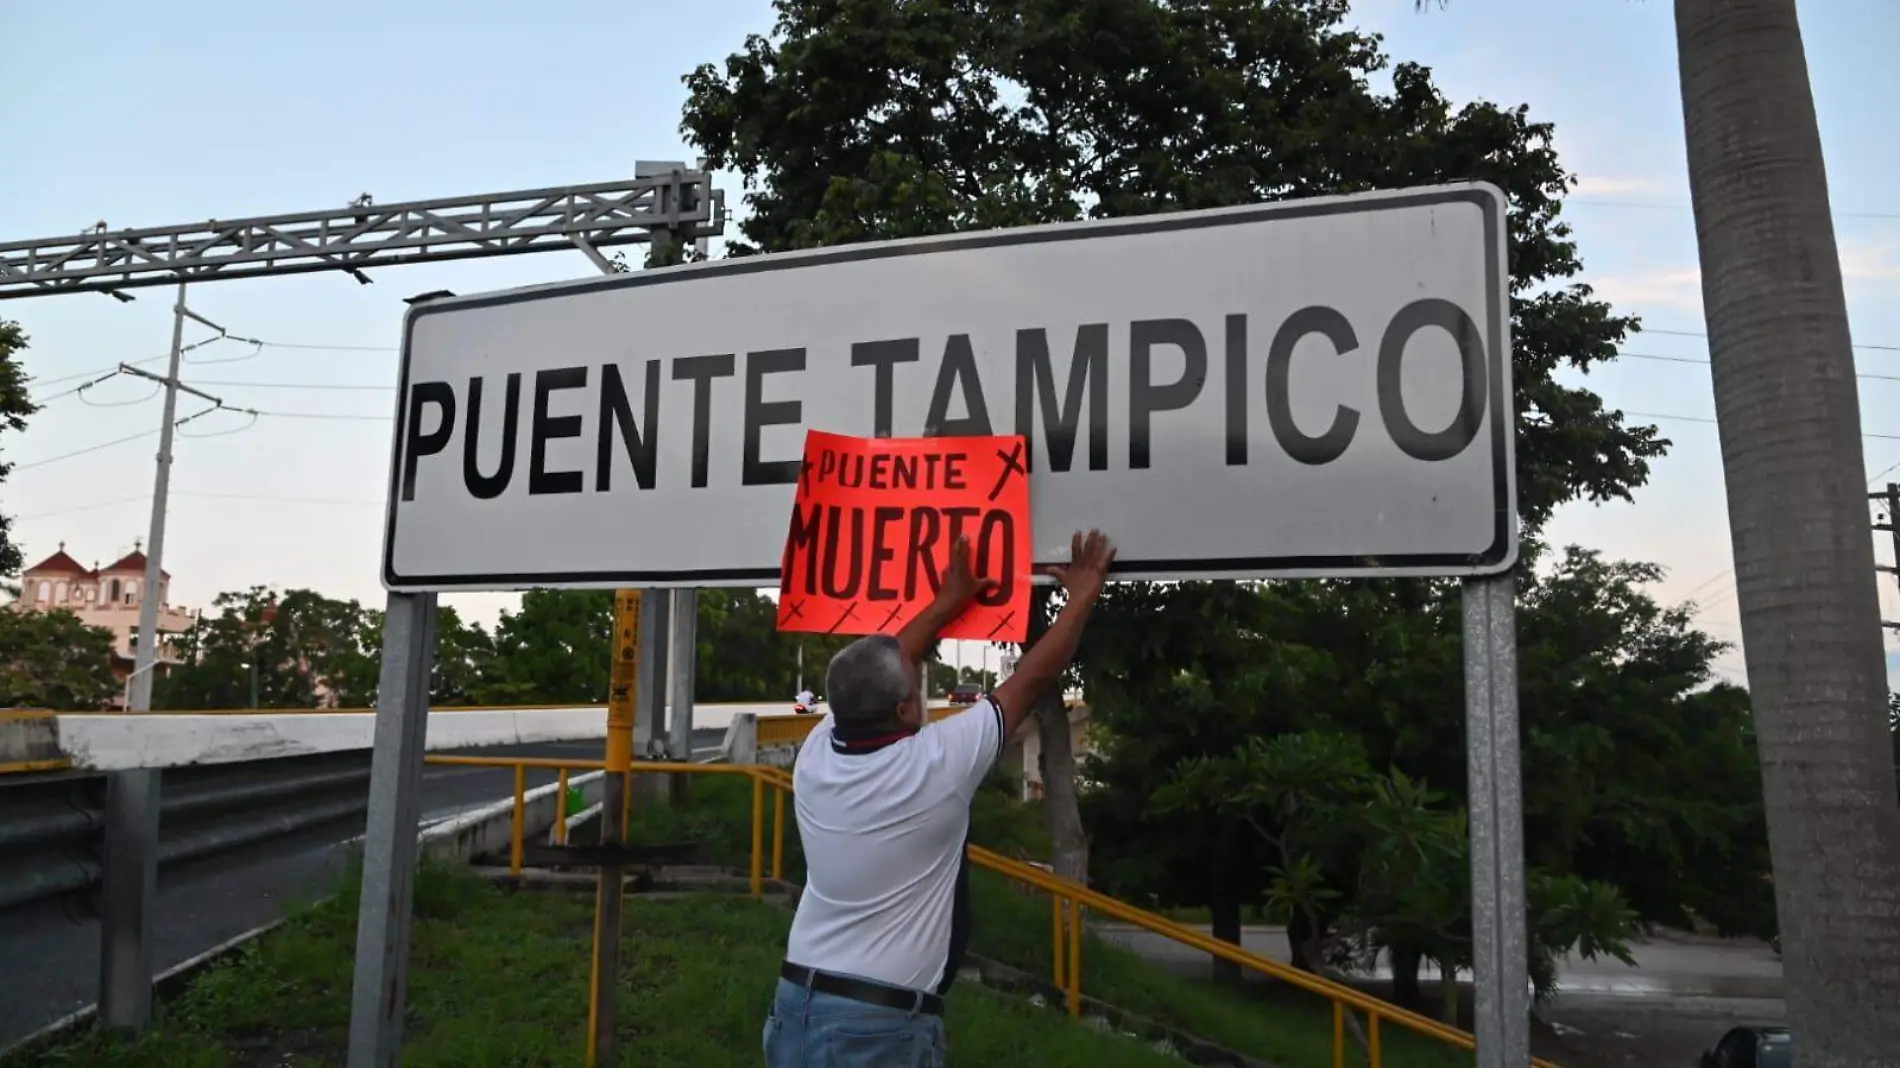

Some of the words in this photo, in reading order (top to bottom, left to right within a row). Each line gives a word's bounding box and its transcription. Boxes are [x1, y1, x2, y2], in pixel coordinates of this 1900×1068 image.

[402, 348, 807, 501] PUENTE
[851, 298, 1487, 473] TAMPICO
[818, 449, 967, 490] PUENTE
[781, 503, 1015, 607] MUERTO
